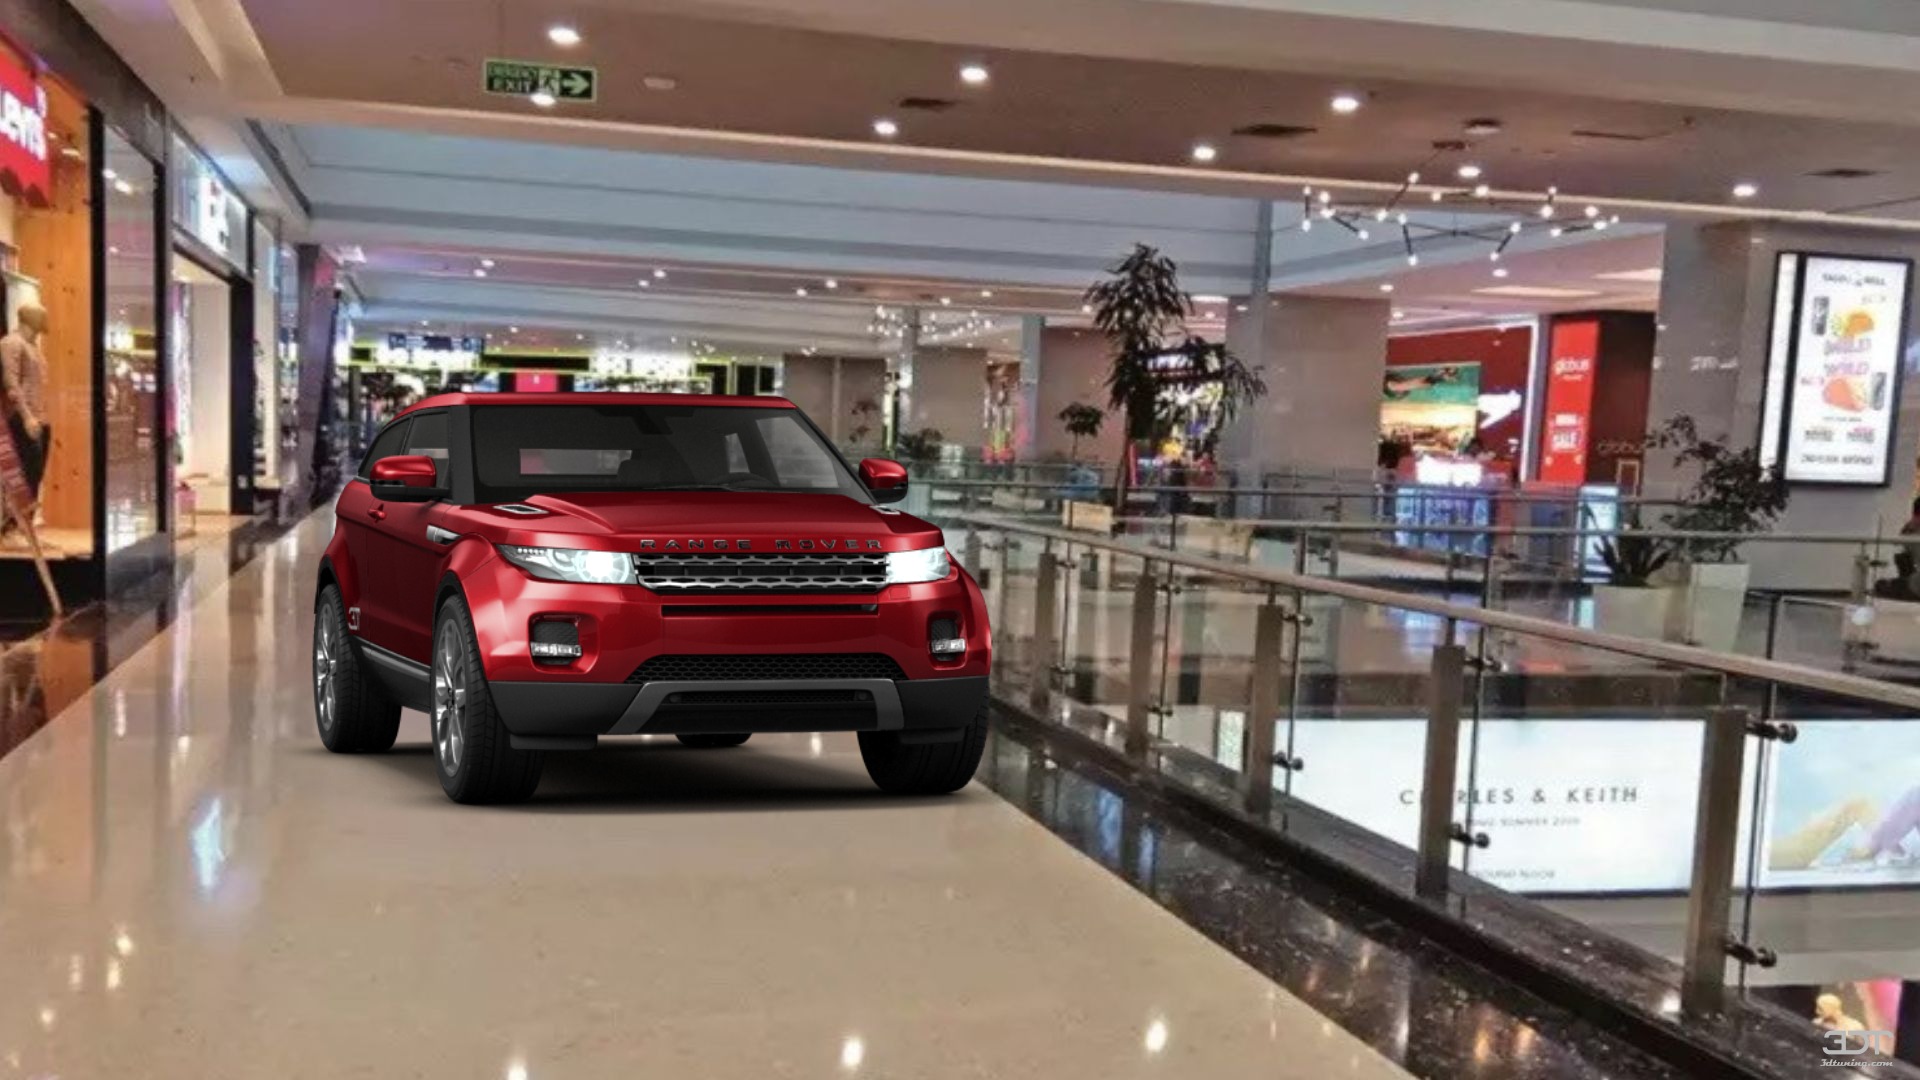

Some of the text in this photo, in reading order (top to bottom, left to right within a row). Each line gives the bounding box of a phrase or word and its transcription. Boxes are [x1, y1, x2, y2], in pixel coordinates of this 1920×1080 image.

[493, 78, 531, 92] EXIT
[640, 539, 882, 549] RANGE ROVER
[1400, 787, 1638, 804] CRLES & KEITH
